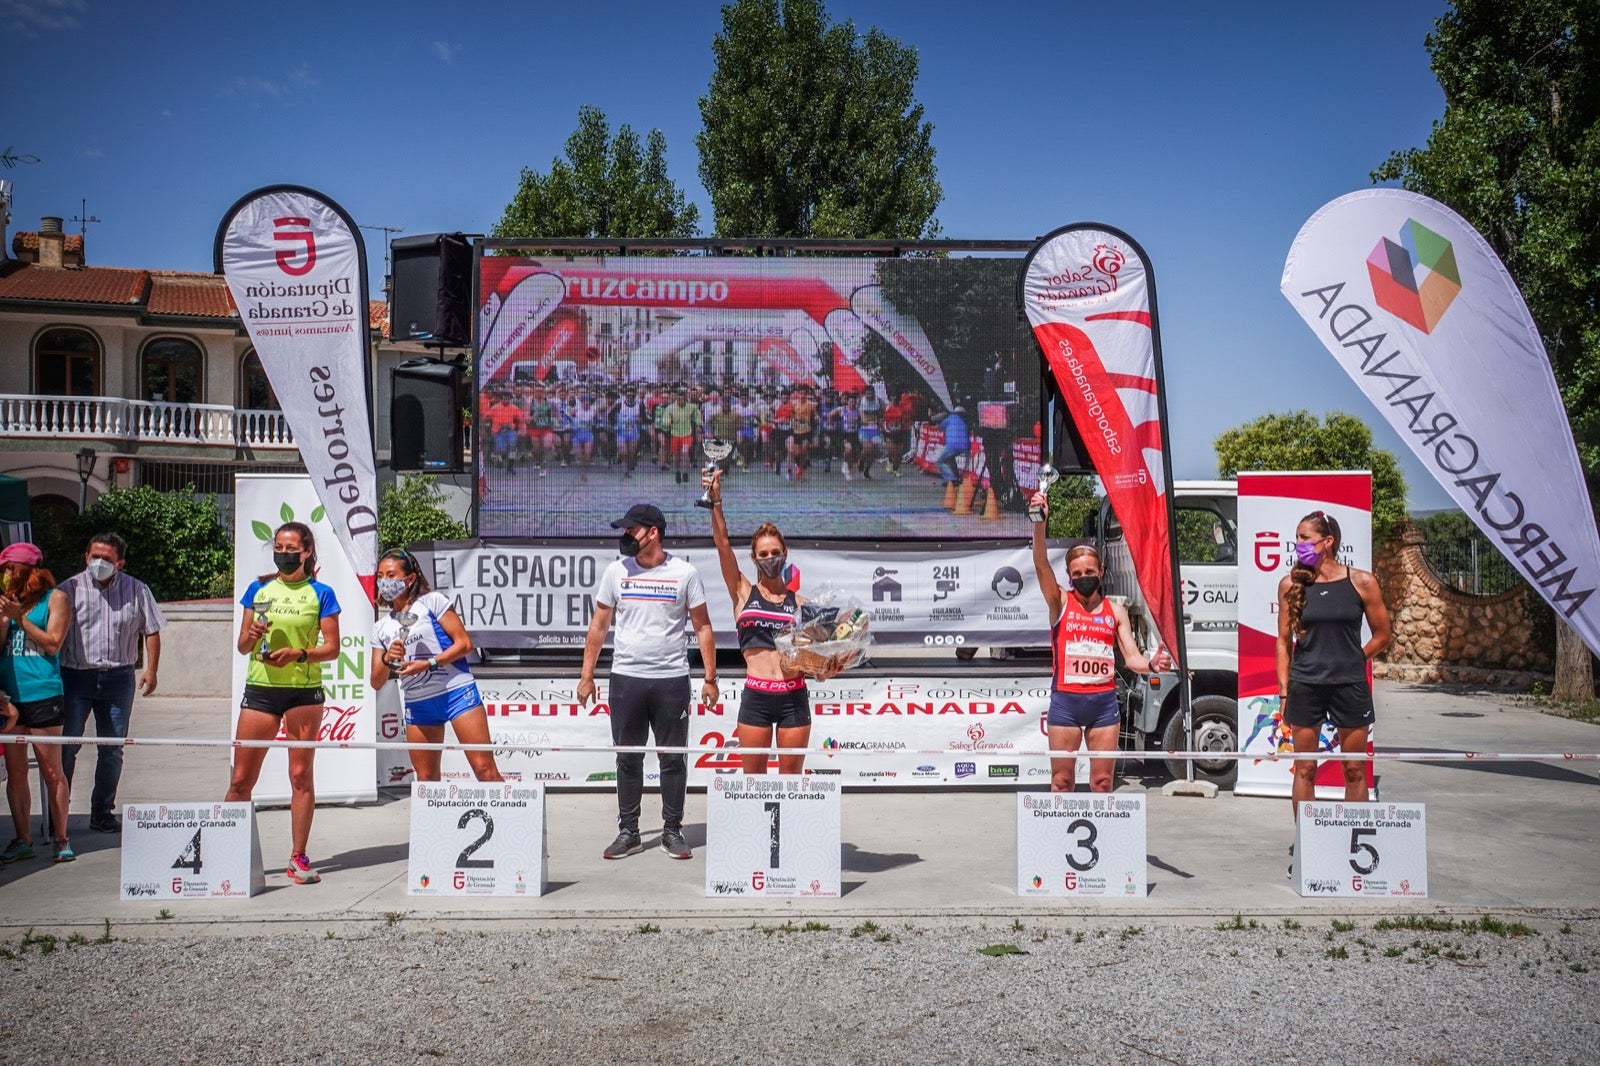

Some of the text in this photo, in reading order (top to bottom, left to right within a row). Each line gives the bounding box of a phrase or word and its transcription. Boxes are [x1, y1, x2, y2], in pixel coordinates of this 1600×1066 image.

[566, 277, 729, 304] ruzcampo
[433, 554, 596, 590] EL ESPACIO
[933, 566, 959, 580] 24H
[620, 581, 678, 593] Champion
[448, 593, 507, 626] ARA
[516, 593, 553, 627] TU
[538, 635, 561, 644] Solicita
[1072, 659, 1109, 675] 1006
[769, 681, 797, 690] PRO
[481, 689, 574, 701] RAN
[814, 701, 1027, 716] GRANADA
[838, 741, 906, 750] MERCAGRANADA
[949, 740, 1014, 751] Sabor Granada
[534, 772, 570, 780] IDEAL
[989, 766, 1015, 774] base
[714, 777, 743, 791] GRAN
[802, 778, 836, 792] FONDO
[418, 785, 446, 799] GRAN
[504, 785, 538, 799] FONDO
[724, 792, 772, 800] Diputación
[788, 792, 825, 800] Granada
[427, 800, 475, 808] Diputación
[490, 800, 527, 808] Granada
[1024, 795, 1051, 809] GRAN
[1107, 796, 1140, 810] FONDO
[127, 806, 156, 820] GRAN
[213, 805, 247, 819] FONDO
[1033, 810, 1130, 819] Diputación de Granada
[1304, 804, 1332, 818] GRAN
[1388, 805, 1421, 820] FONDO
[137, 821, 185, 830] Diputación
[199, 820, 236, 828] Granada
[1314, 819, 1360, 828] Diputación
[1375, 820, 1411, 828] Granada
[455, 809, 494, 868] 2
[764, 802, 780, 868] 1
[171, 827, 203, 874] 4
[1065, 819, 1099, 871] 3
[1349, 828, 1379, 875] 5
